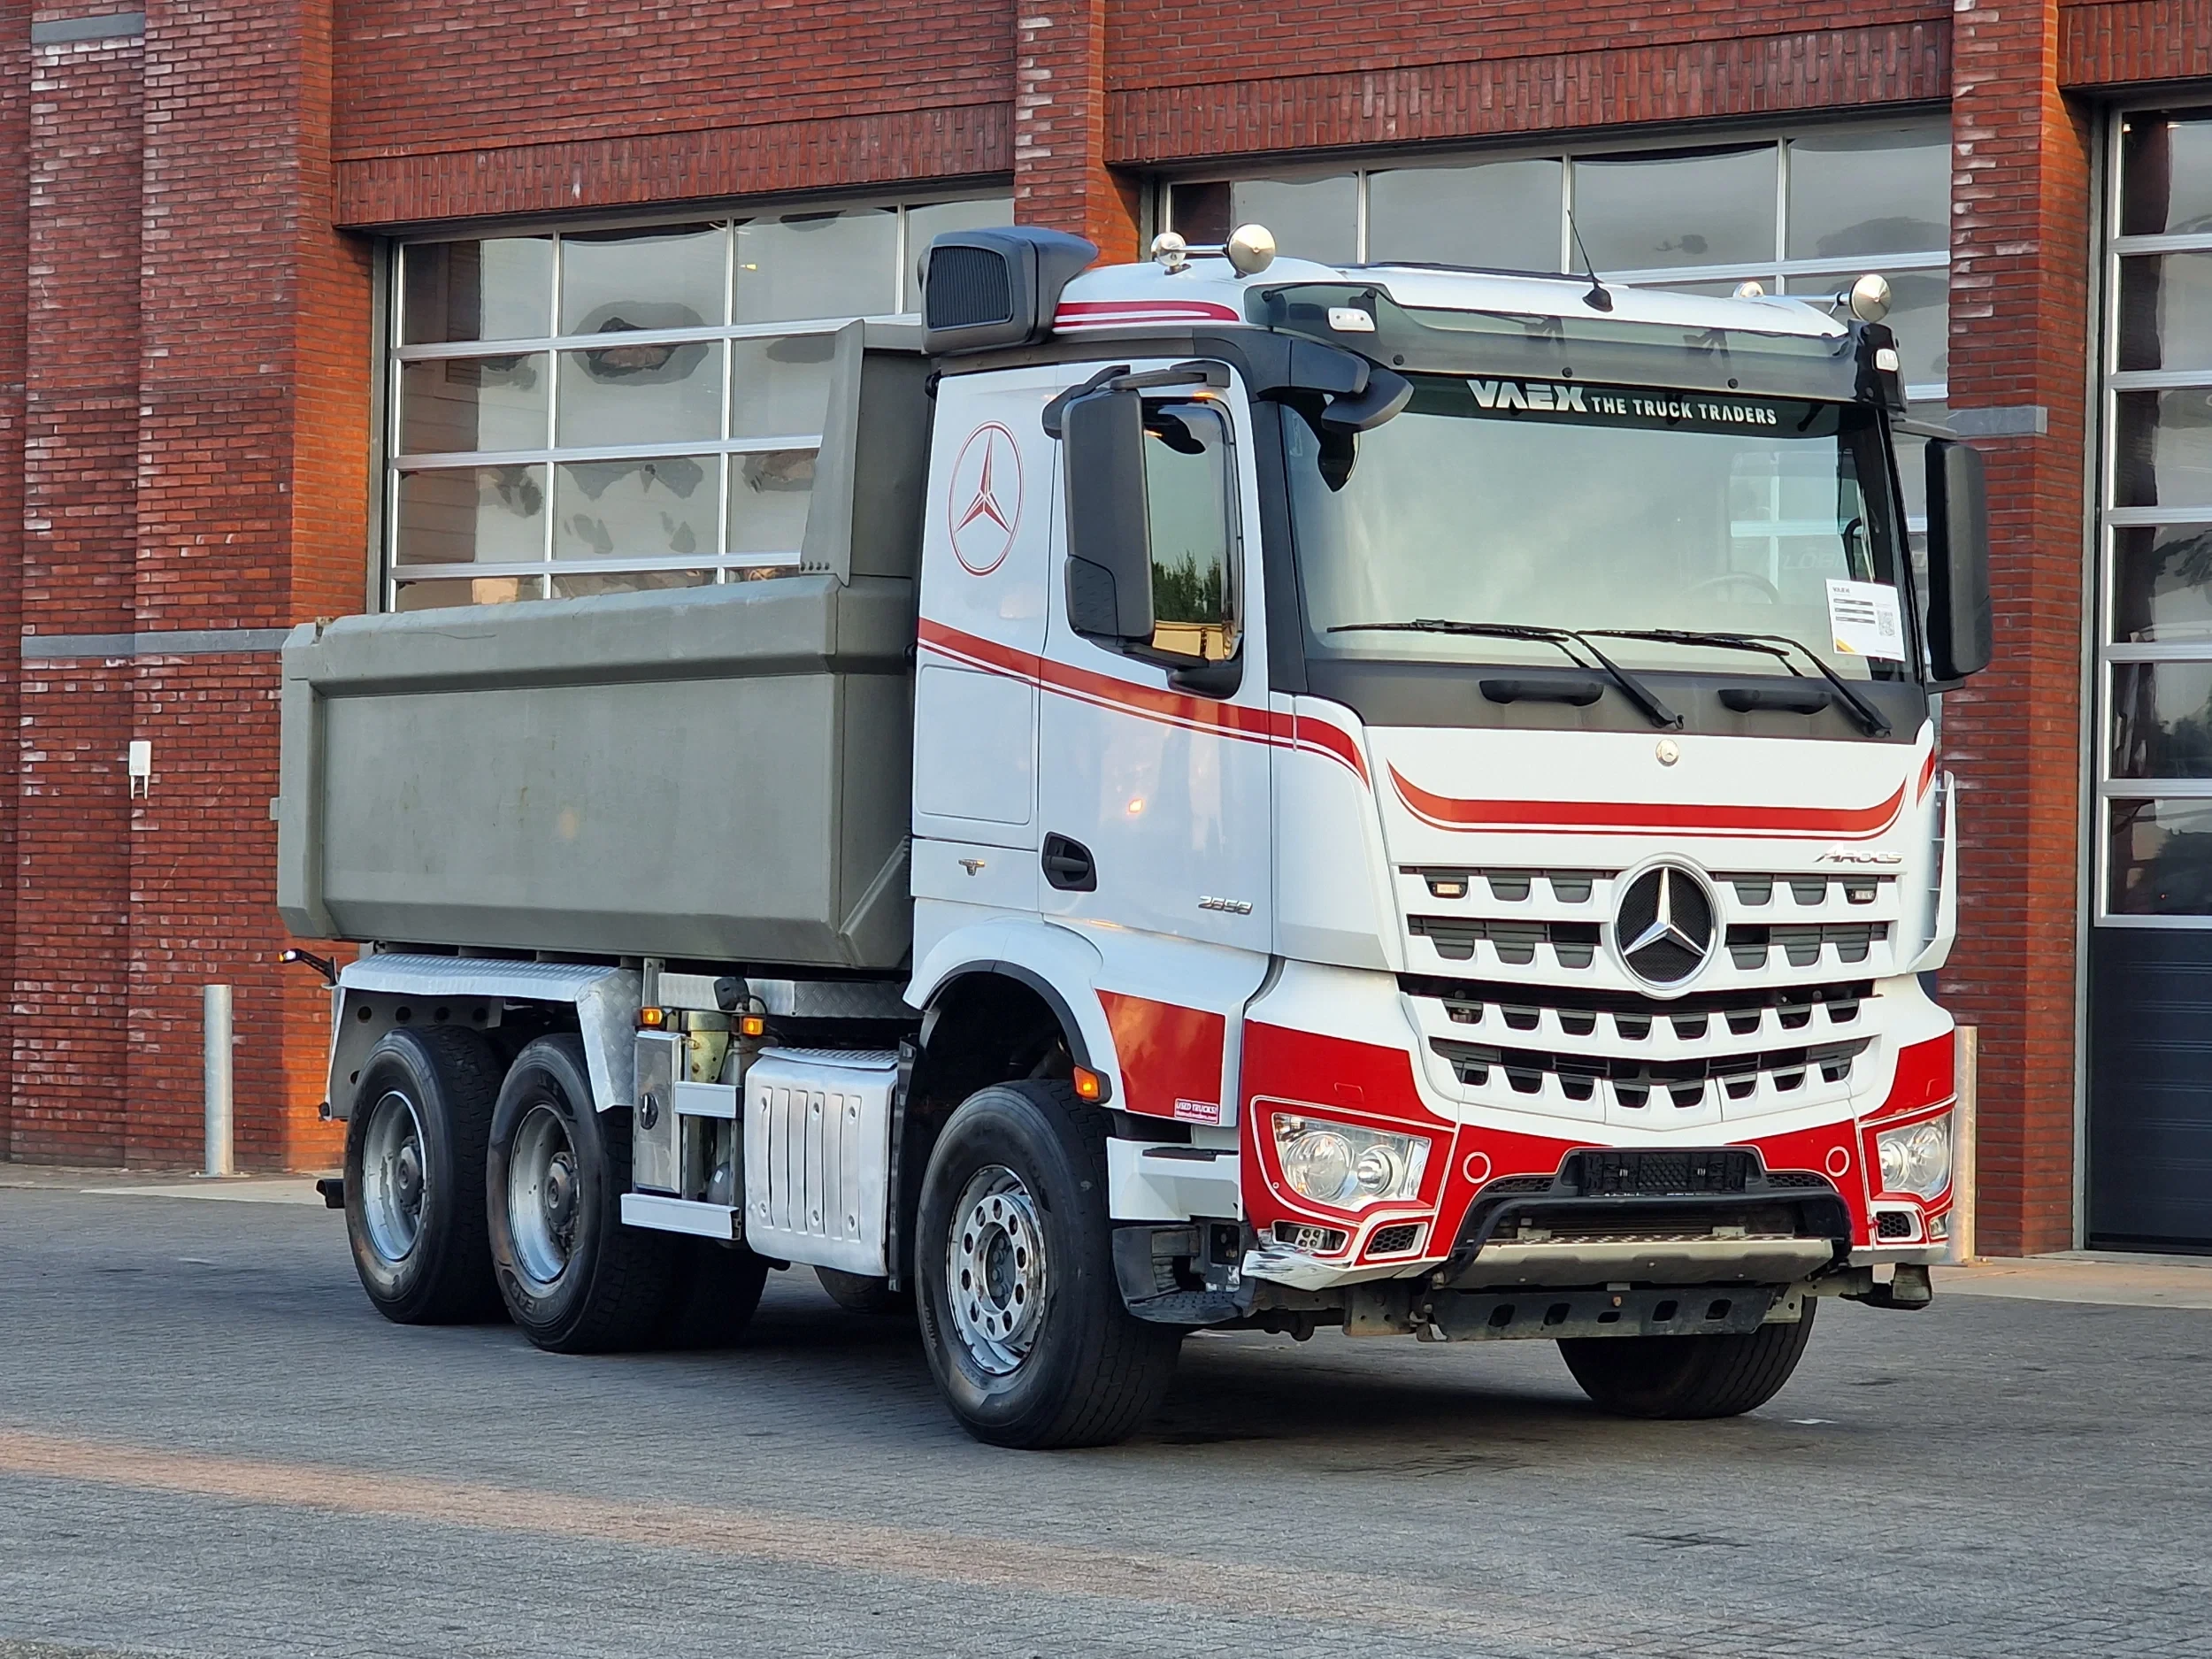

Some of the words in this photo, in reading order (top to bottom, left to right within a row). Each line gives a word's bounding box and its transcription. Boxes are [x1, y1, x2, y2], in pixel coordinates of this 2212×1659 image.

[1466, 380, 1587, 412] VAEX
[1591, 397, 1627, 414] THE
[1632, 399, 1694, 419] TRUCK
[1698, 403, 1777, 426] TRADERS
